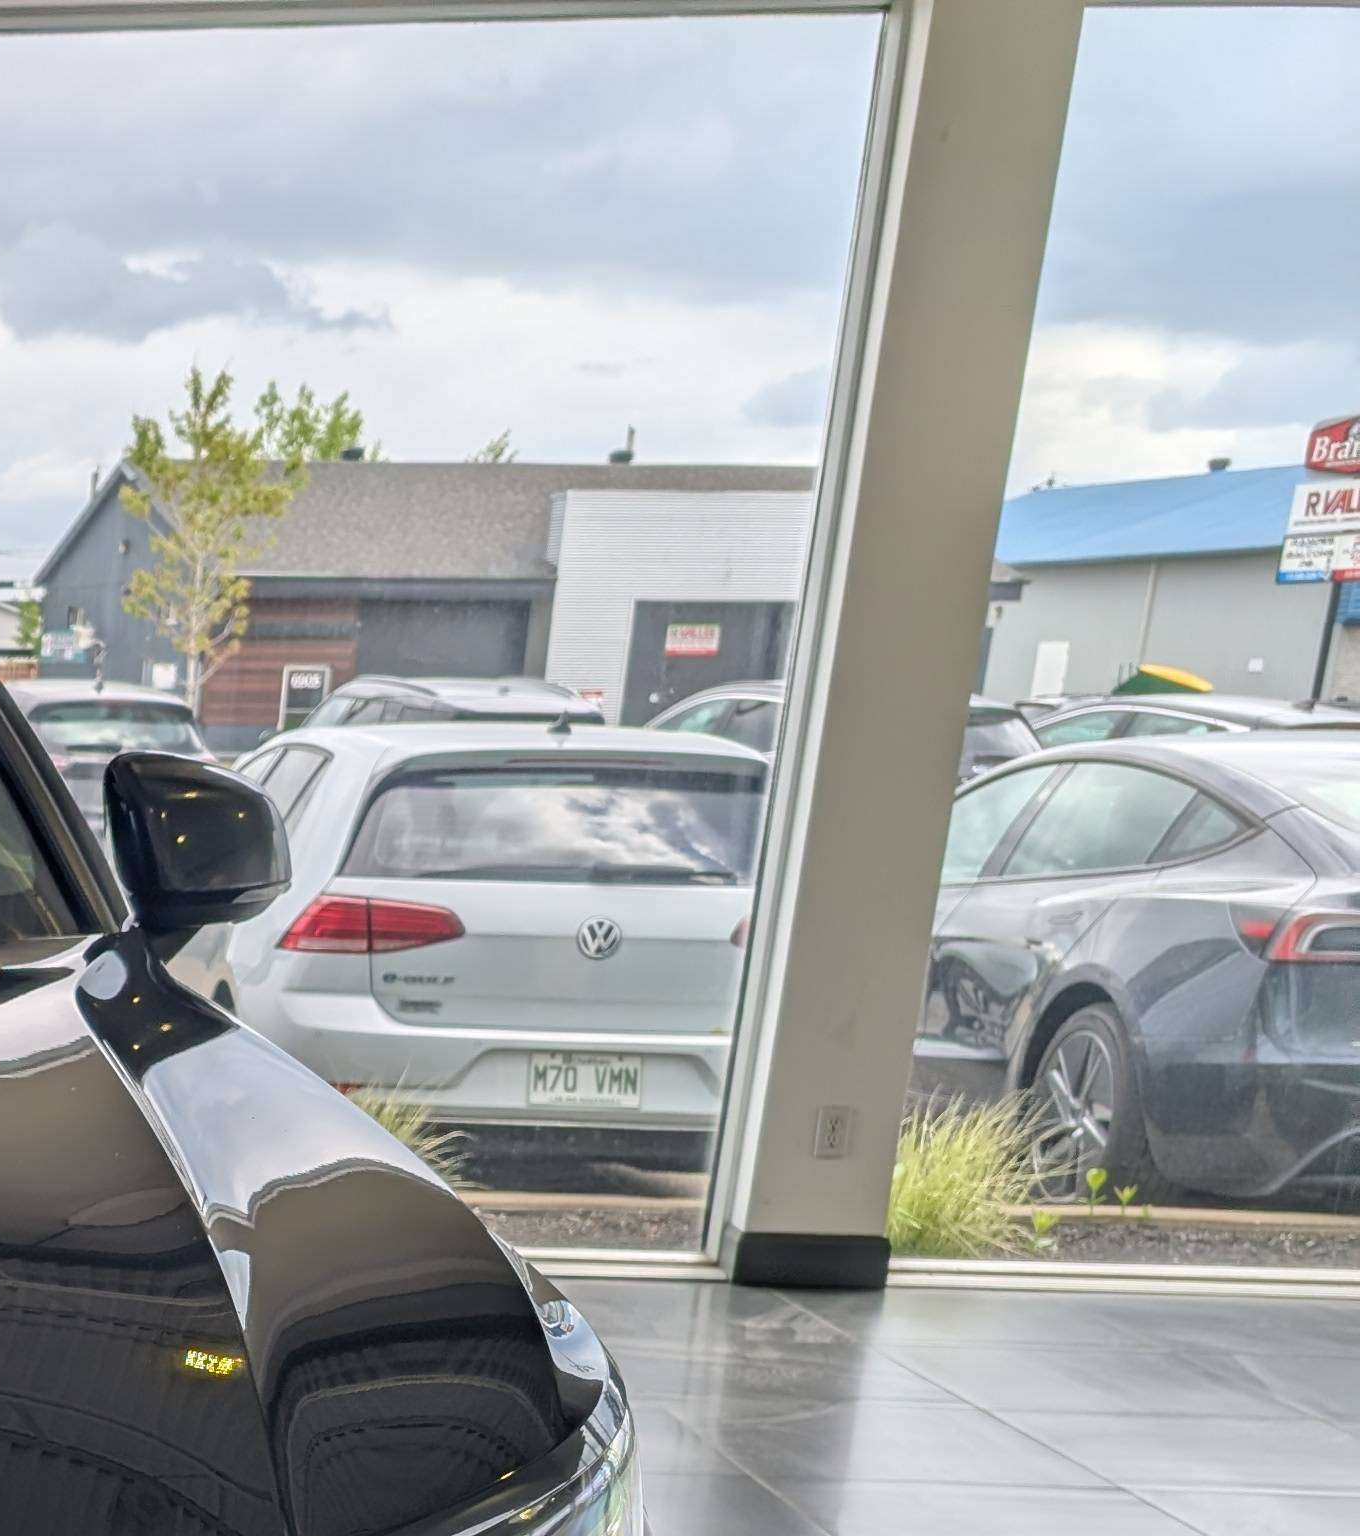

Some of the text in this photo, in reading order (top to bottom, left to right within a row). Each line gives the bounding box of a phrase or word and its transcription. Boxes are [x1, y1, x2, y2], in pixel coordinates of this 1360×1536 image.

[1323, 488, 1360, 516] VAL
[533, 1064, 638, 1095] M70 VMN
